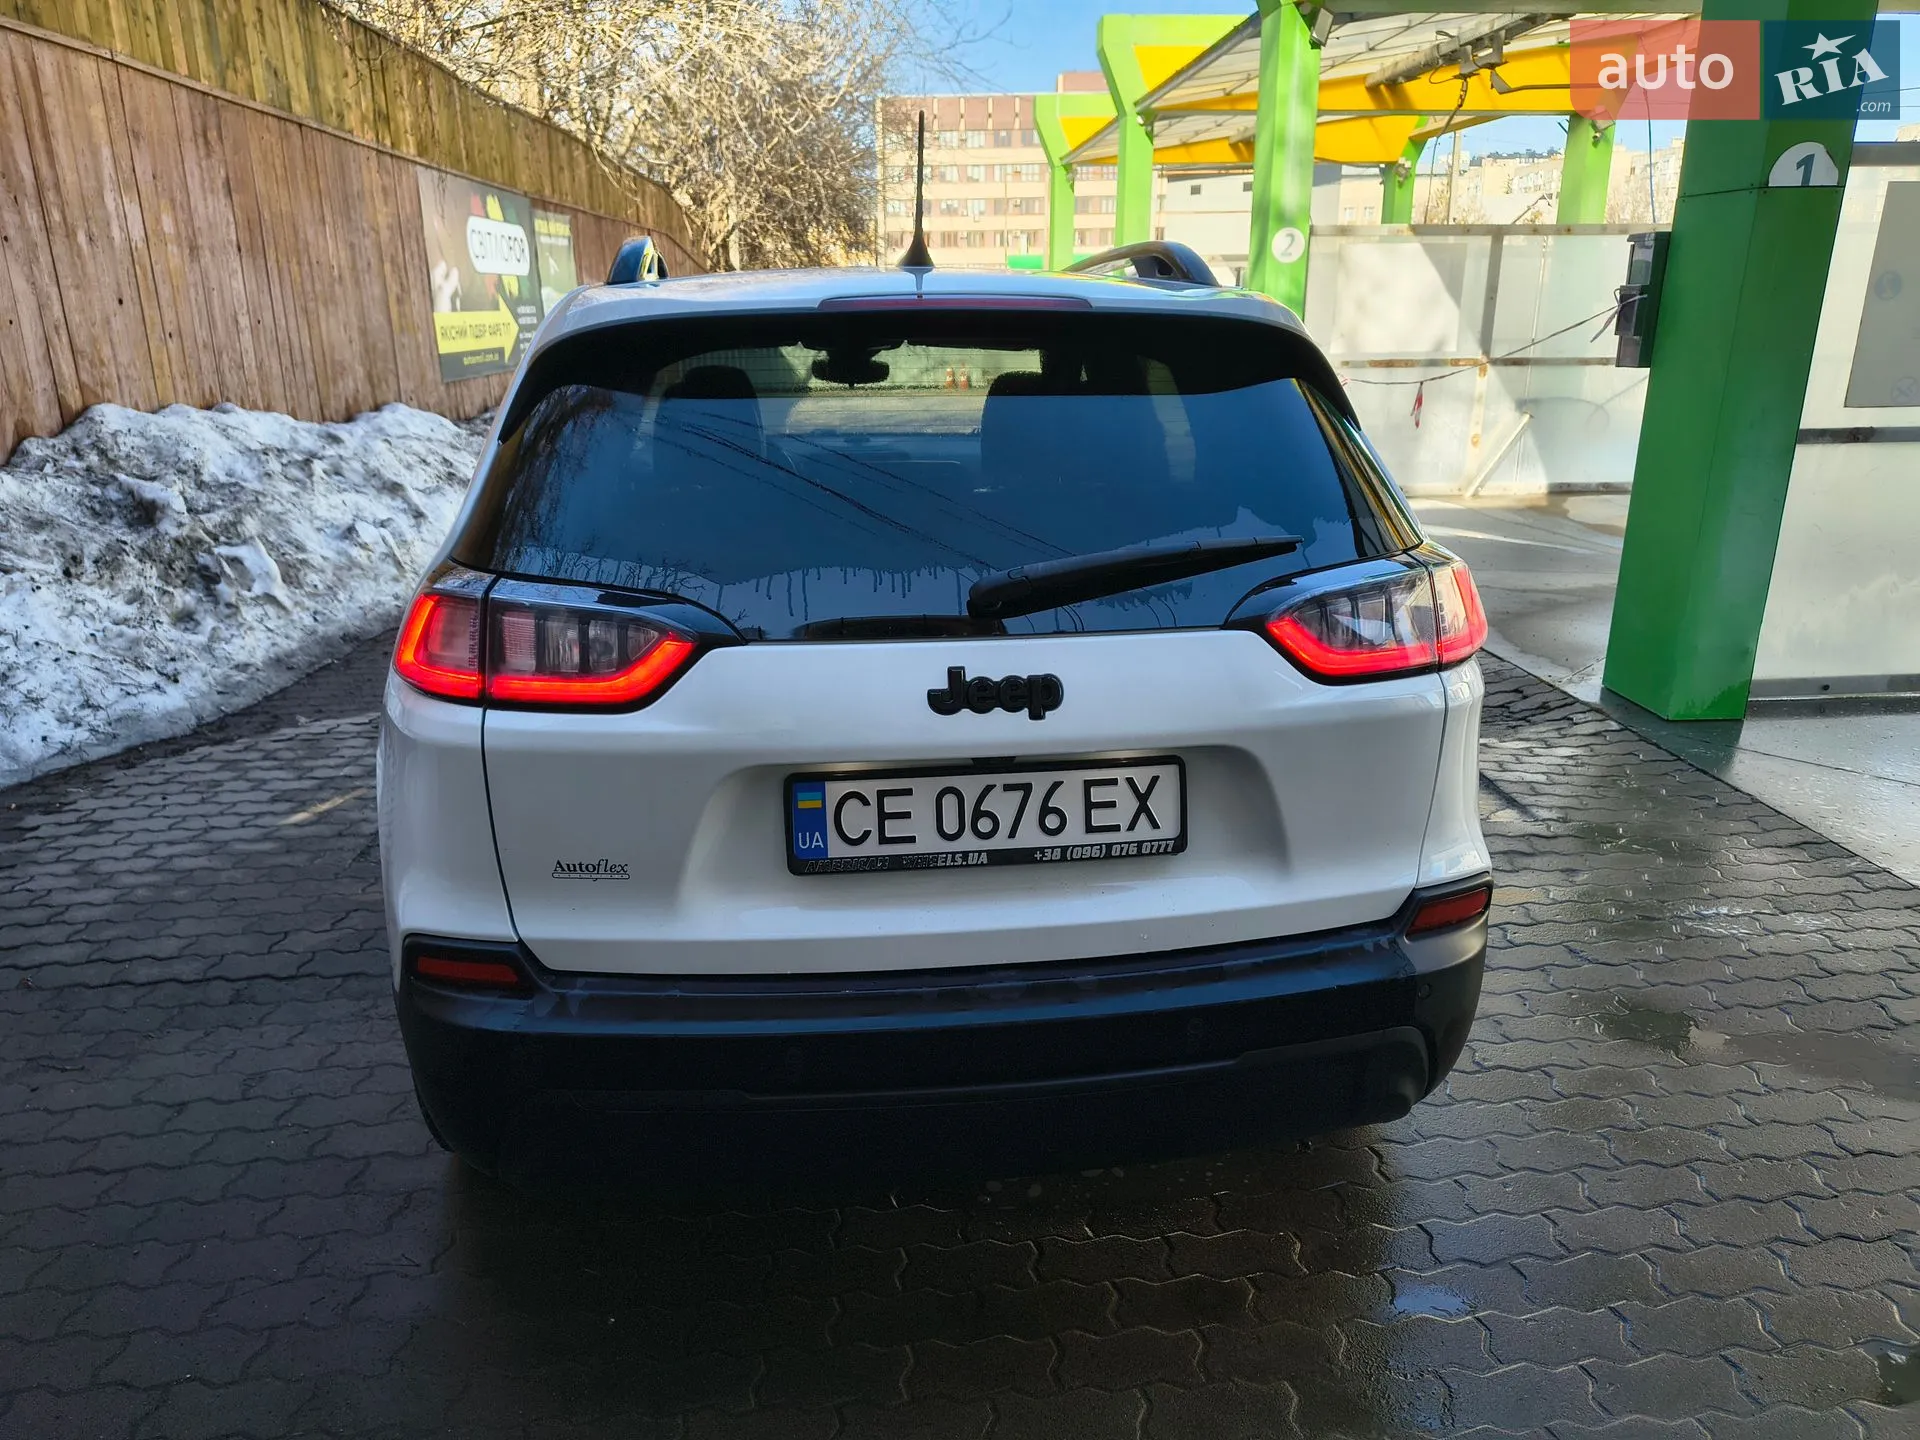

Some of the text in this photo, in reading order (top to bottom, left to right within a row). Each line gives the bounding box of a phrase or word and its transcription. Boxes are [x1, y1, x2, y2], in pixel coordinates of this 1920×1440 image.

[1795, 153, 1816, 187] 1
[1281, 233, 1295, 257] 2
[927, 666, 1064, 721] Jeep
[834, 775, 1161, 846] CE 0676 EX
[798, 832, 824, 849] UA
[805, 857, 890, 873] AMERICAN
[1034, 848, 1061, 862] +38
[1066, 844, 1106, 861] (096)
[1111, 842, 1138, 856] 076
[1142, 840, 1175, 854] 0777
[553, 858, 628, 880] Autoflex
